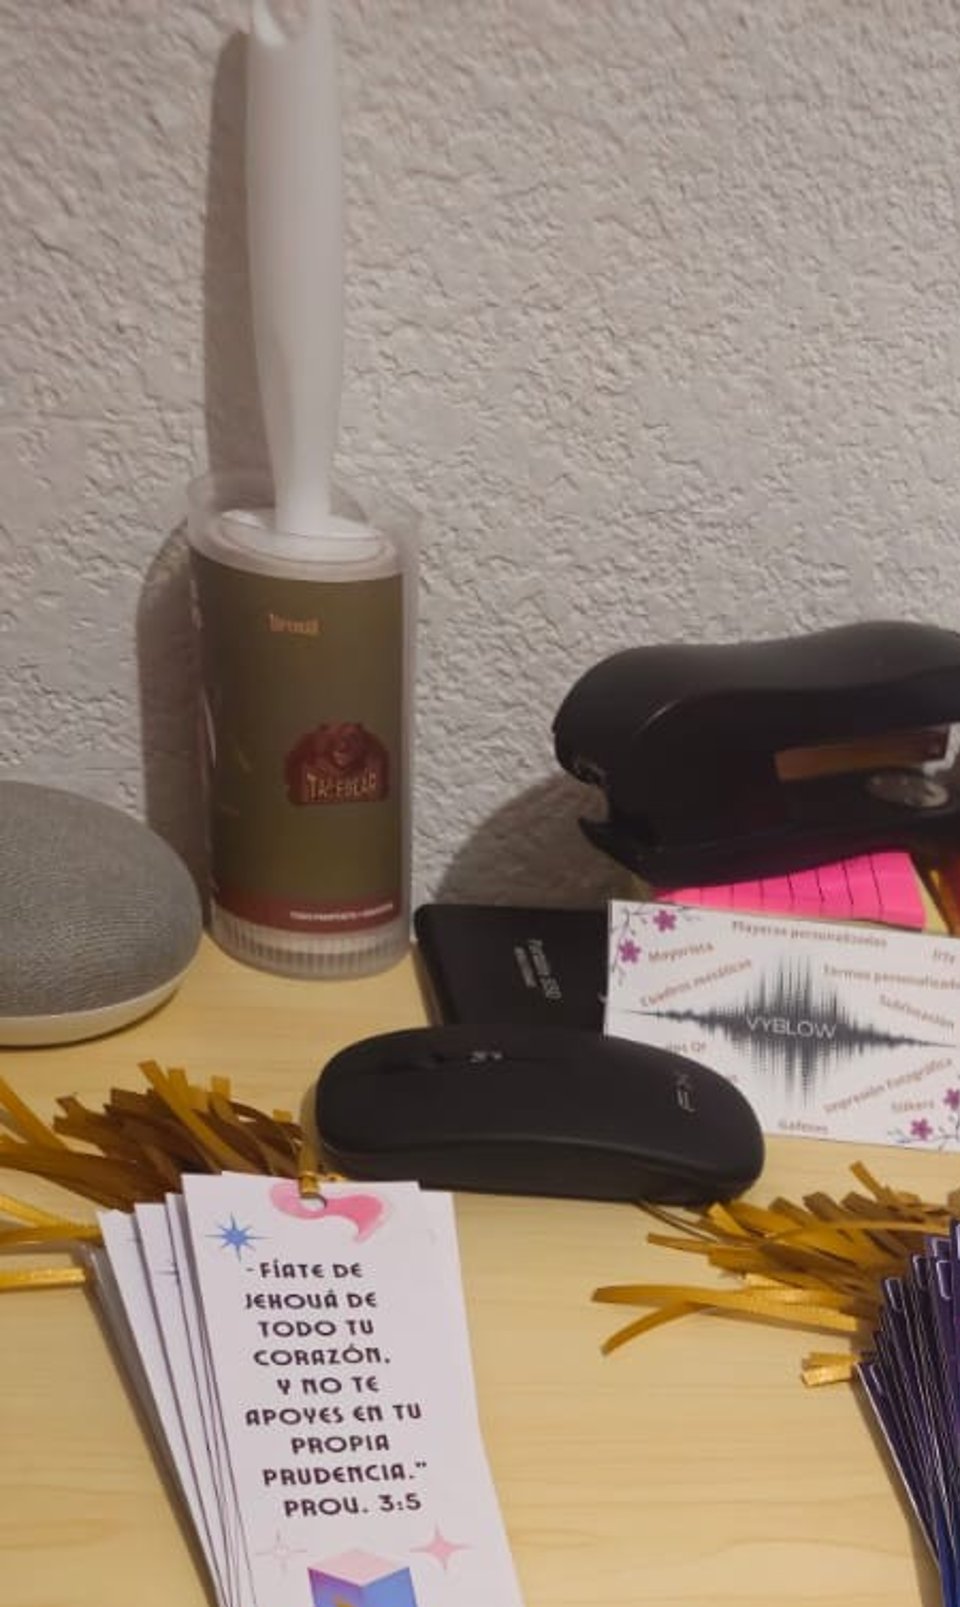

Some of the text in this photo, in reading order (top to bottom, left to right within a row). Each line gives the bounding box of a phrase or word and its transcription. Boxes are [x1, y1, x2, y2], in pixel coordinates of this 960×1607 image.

[746, 1015, 838, 1039] VYBLOW
[332, 1262, 364, 1279] DE
[244, 1289, 378, 1310] JEHOVÁ DE
[258, 1318, 375, 1338] TODO TU
[277, 1375, 381, 1396] Y NO TE
[244, 1402, 423, 1426] APOYES EN TU
[290, 1433, 390, 1455] PROPIA
[378, 1493, 423, 1513] 3:5
